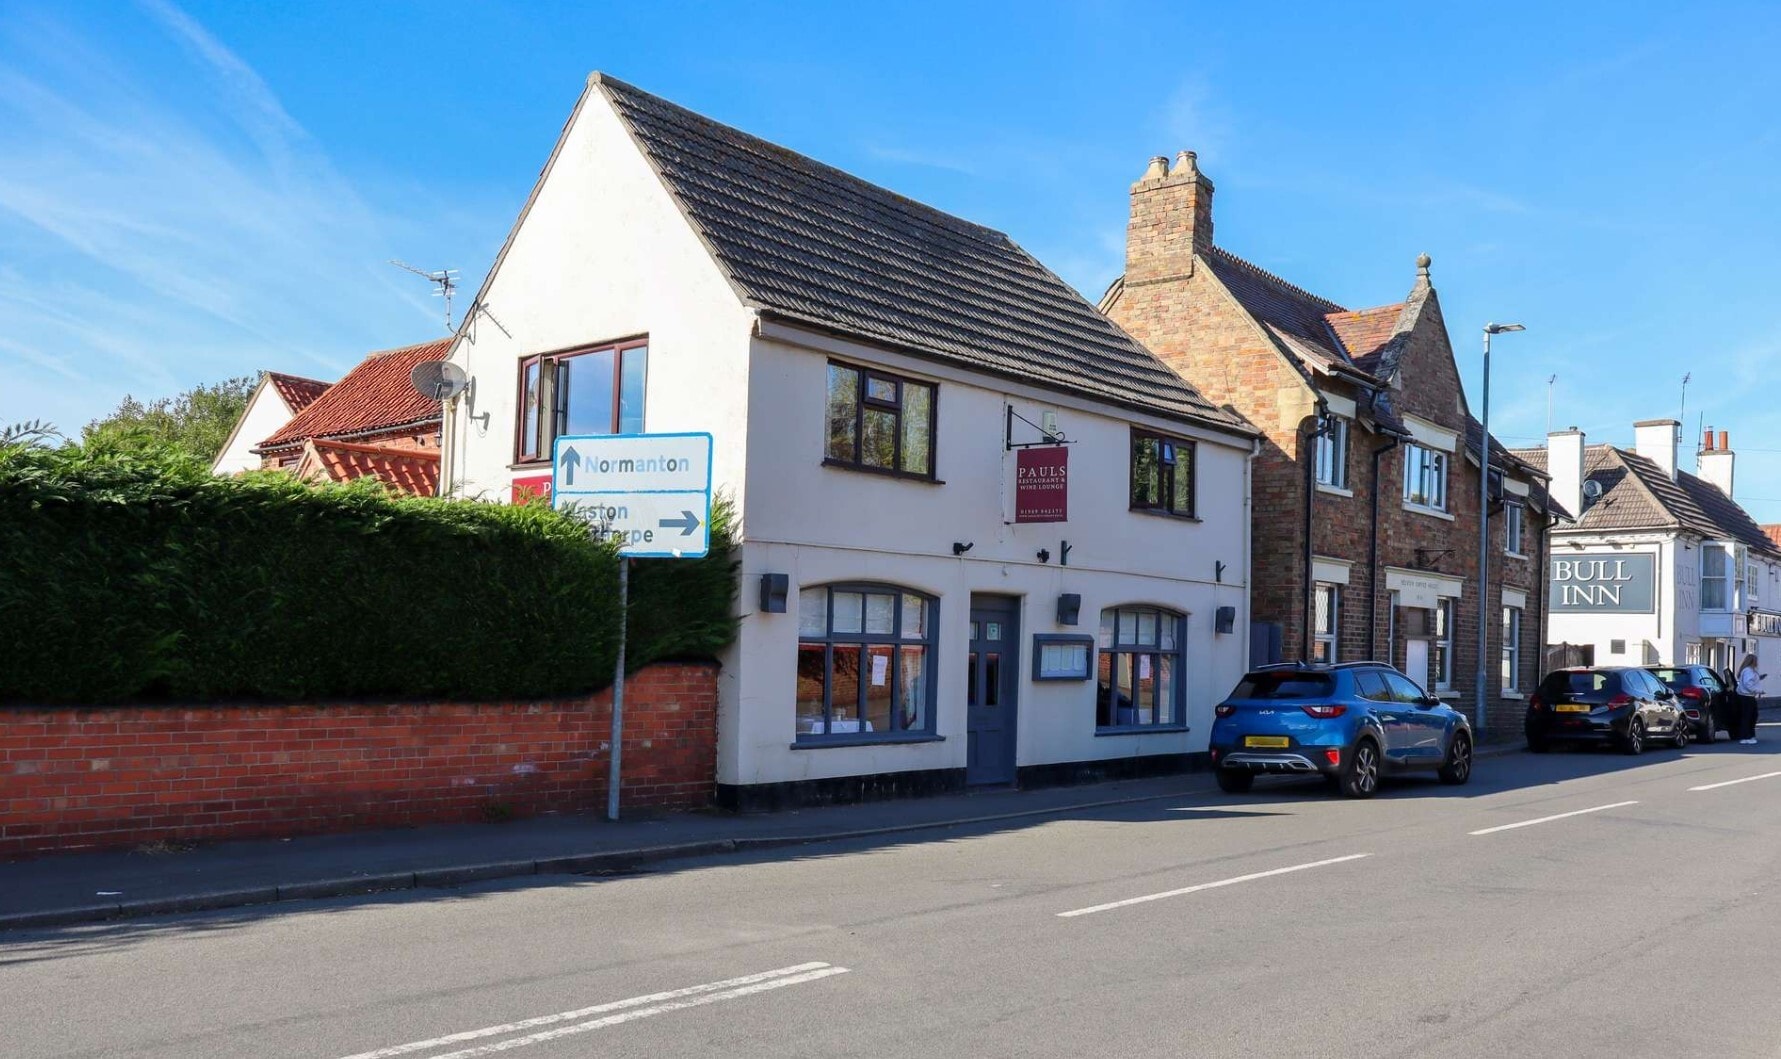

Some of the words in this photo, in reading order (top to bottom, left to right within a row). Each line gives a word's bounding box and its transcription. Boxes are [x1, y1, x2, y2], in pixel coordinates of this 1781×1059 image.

[584, 455, 690, 474] Normanton
[1018, 466, 1066, 478] PAULS
[1552, 560, 1633, 582] BULL
[1561, 584, 1622, 606] INN
